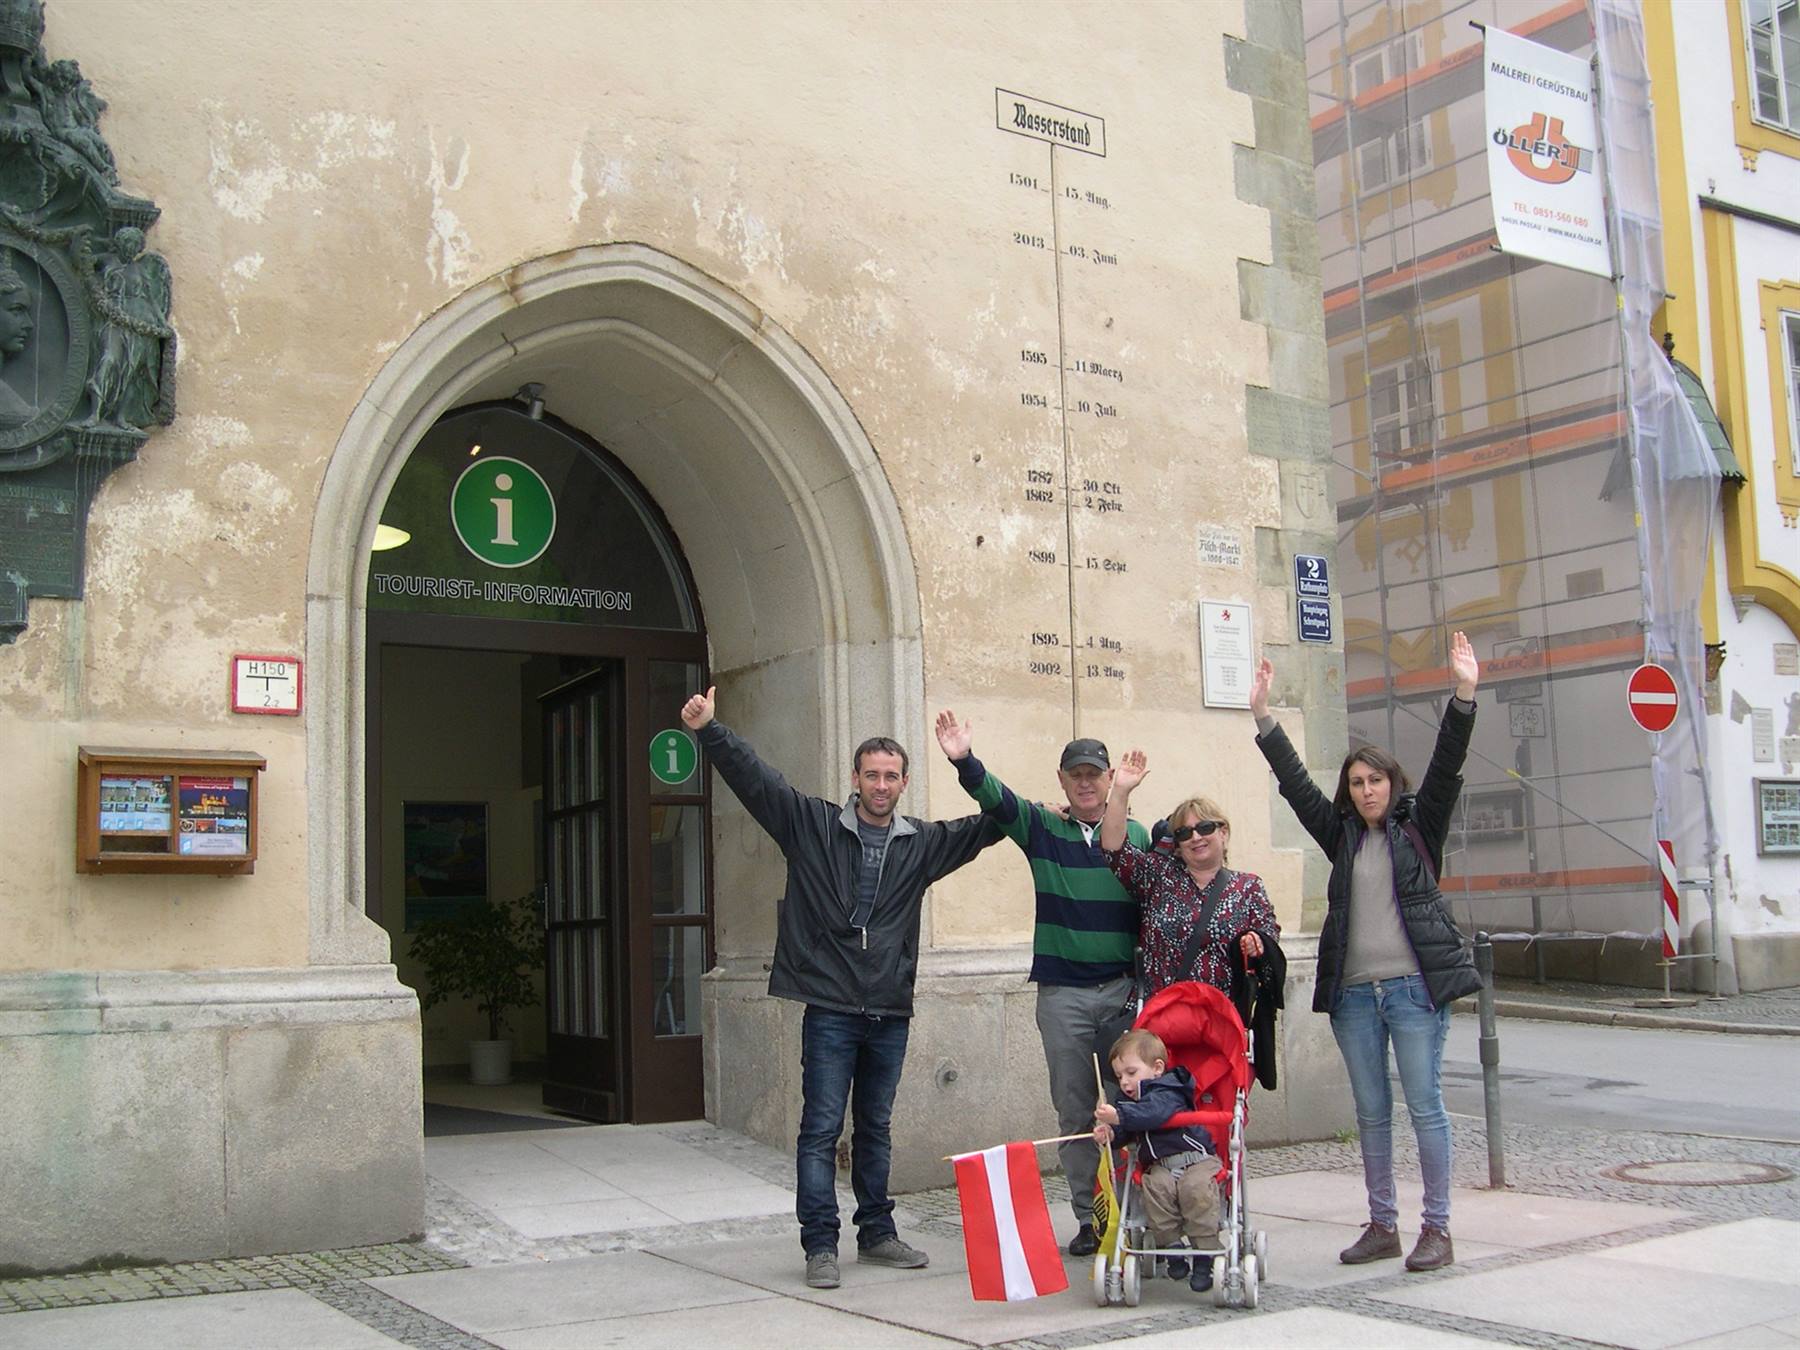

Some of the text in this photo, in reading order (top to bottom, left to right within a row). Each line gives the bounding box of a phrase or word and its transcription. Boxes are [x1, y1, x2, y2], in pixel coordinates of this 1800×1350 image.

[1491, 62, 1588, 103] MALEREI GERÜSTBAU
[1013, 102, 1090, 147] Wasserstand
[1492, 127, 1560, 160] ÖLLER
[1008, 172, 1038, 190] 1501
[1013, 231, 1045, 250] 2013
[1093, 249, 1117, 266] Juni
[1021, 350, 1047, 365] 1595
[1021, 393, 1047, 408] 1954
[1027, 470, 1053, 484] 1787
[1025, 489, 1053, 503] 1862
[1306, 559, 1319, 579] 2
[1031, 633, 1059, 646] 1895
[1029, 662, 1061, 676] 2002
